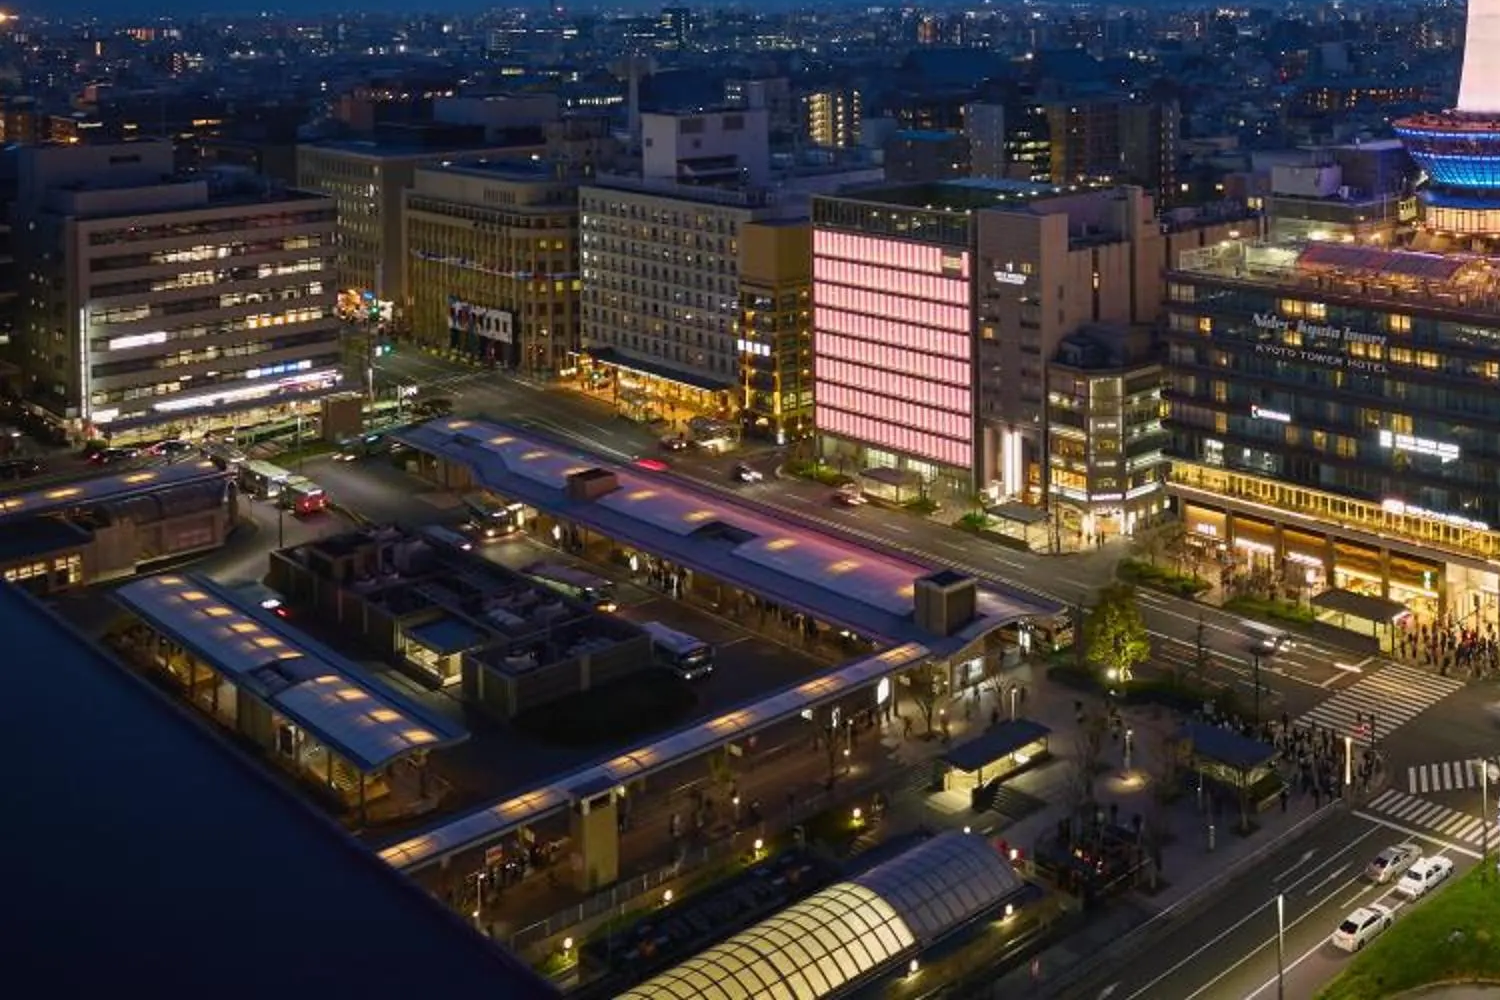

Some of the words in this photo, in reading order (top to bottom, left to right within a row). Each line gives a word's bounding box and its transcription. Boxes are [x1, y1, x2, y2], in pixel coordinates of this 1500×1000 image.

[1252, 312, 1289, 329] Nidec
[1297, 319, 1341, 339] Kyoto
[1343, 327, 1387, 345] Tower
[1255, 344, 1297, 357] KYOTO
[1301, 351, 1343, 365] TOWER
[1347, 359, 1387, 373] HOTEL
